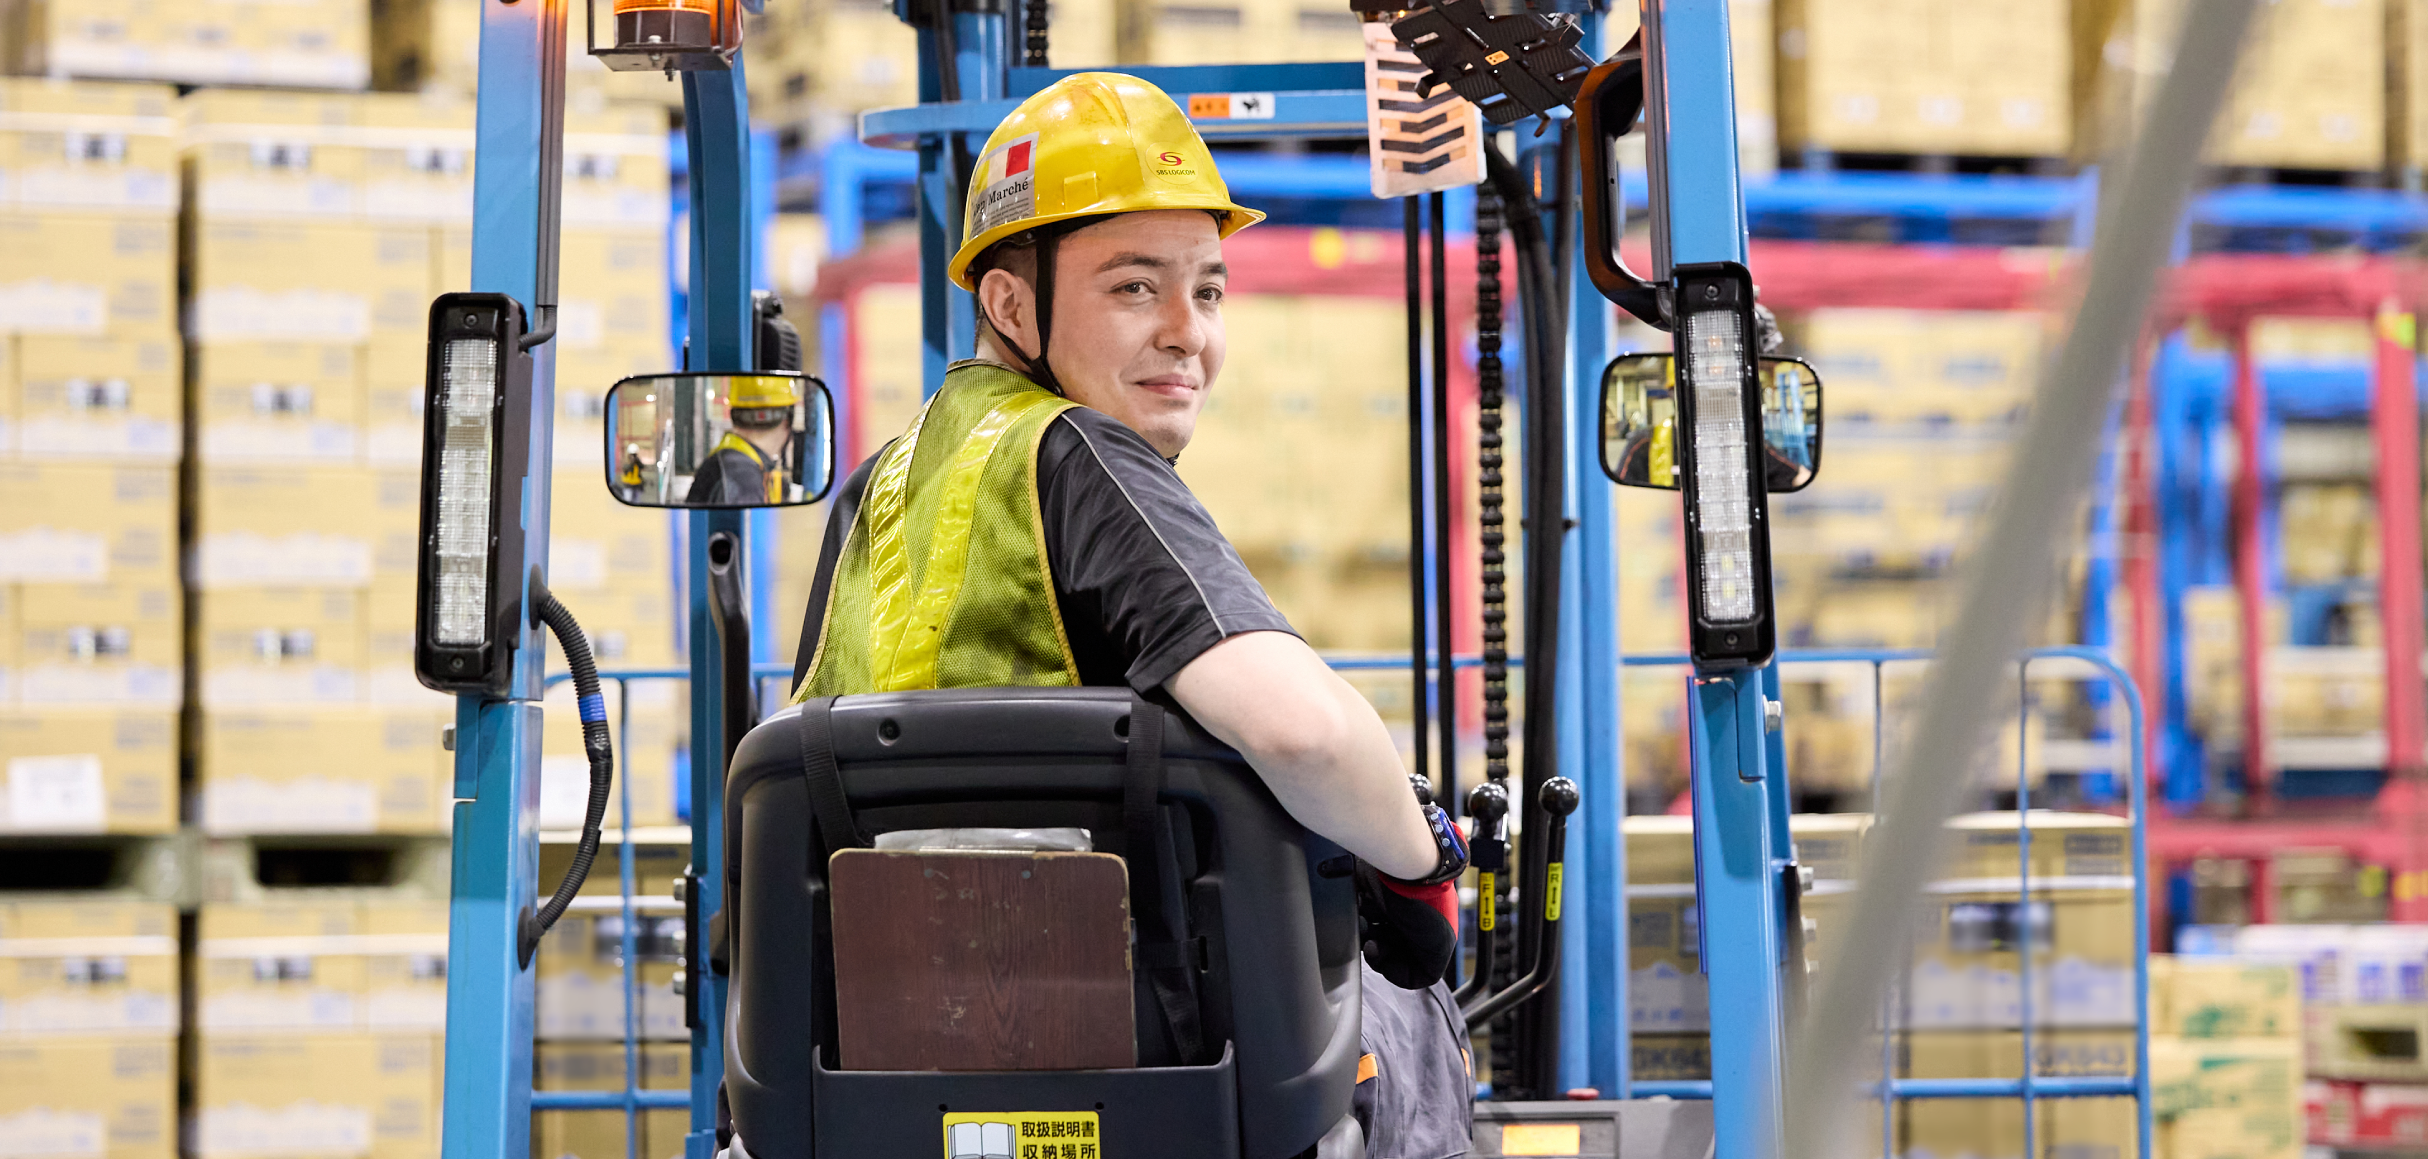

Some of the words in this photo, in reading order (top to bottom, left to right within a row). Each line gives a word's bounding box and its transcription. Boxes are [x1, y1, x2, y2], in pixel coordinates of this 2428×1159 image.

[988, 177, 1029, 206] Marché
[1550, 874, 1559, 882] R
[1482, 884, 1491, 892] F
[1549, 907, 1556, 917] L
[1482, 918, 1491, 927] B
[1021, 1121, 1095, 1138] 取扱説明書
[1023, 1143, 1096, 1159] 収納場所
